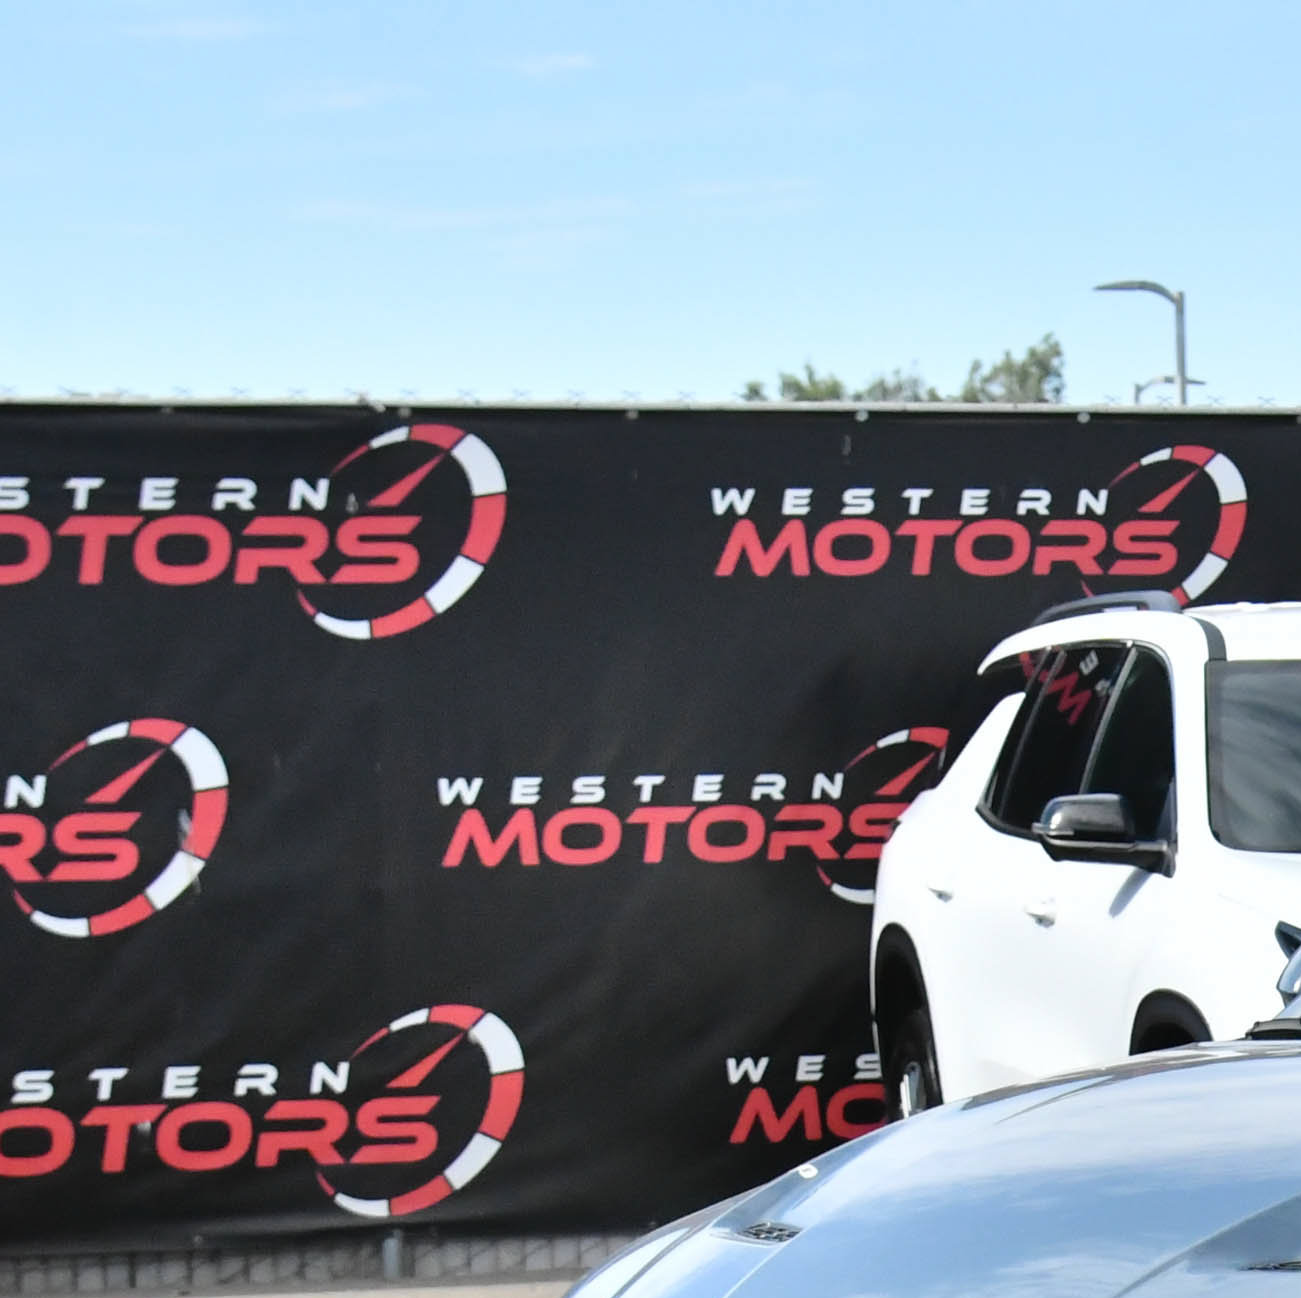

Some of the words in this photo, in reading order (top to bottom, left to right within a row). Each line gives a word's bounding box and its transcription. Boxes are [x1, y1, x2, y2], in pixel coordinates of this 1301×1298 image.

[0, 477, 329, 511] STERN
[711, 487, 1108, 516] WESTERN
[0, 513, 421, 586] OTORS
[715, 518, 1179, 577] MOTORS
[438, 772, 843, 805] WESTERN
[442, 802, 909, 868] MOTORS
[12, 1061, 349, 1104] STERN
[0, 1095, 440, 1177] OTORS
